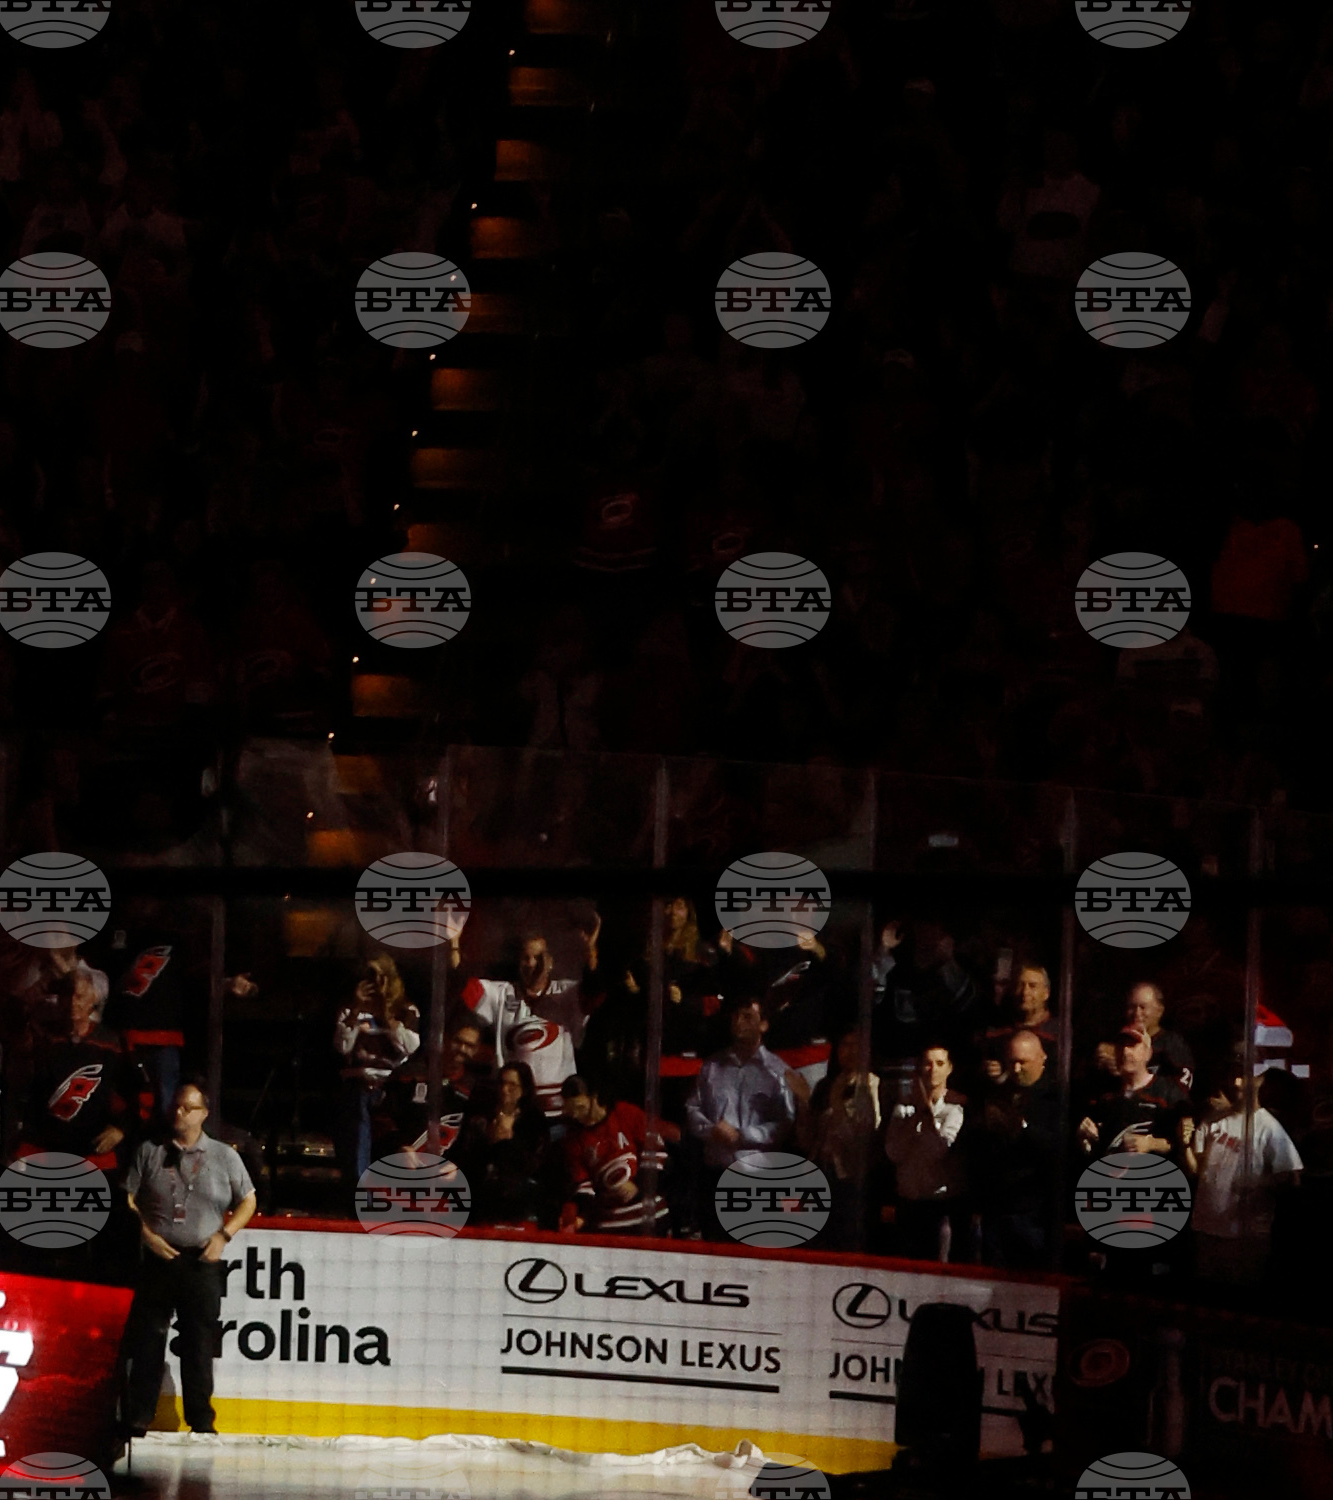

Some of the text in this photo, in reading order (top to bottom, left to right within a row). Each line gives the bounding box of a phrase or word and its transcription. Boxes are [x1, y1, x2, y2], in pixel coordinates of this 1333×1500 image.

[574, 1273, 751, 1309] LEXUS
[501, 1327, 782, 1374] JOHNSON LEXUS
